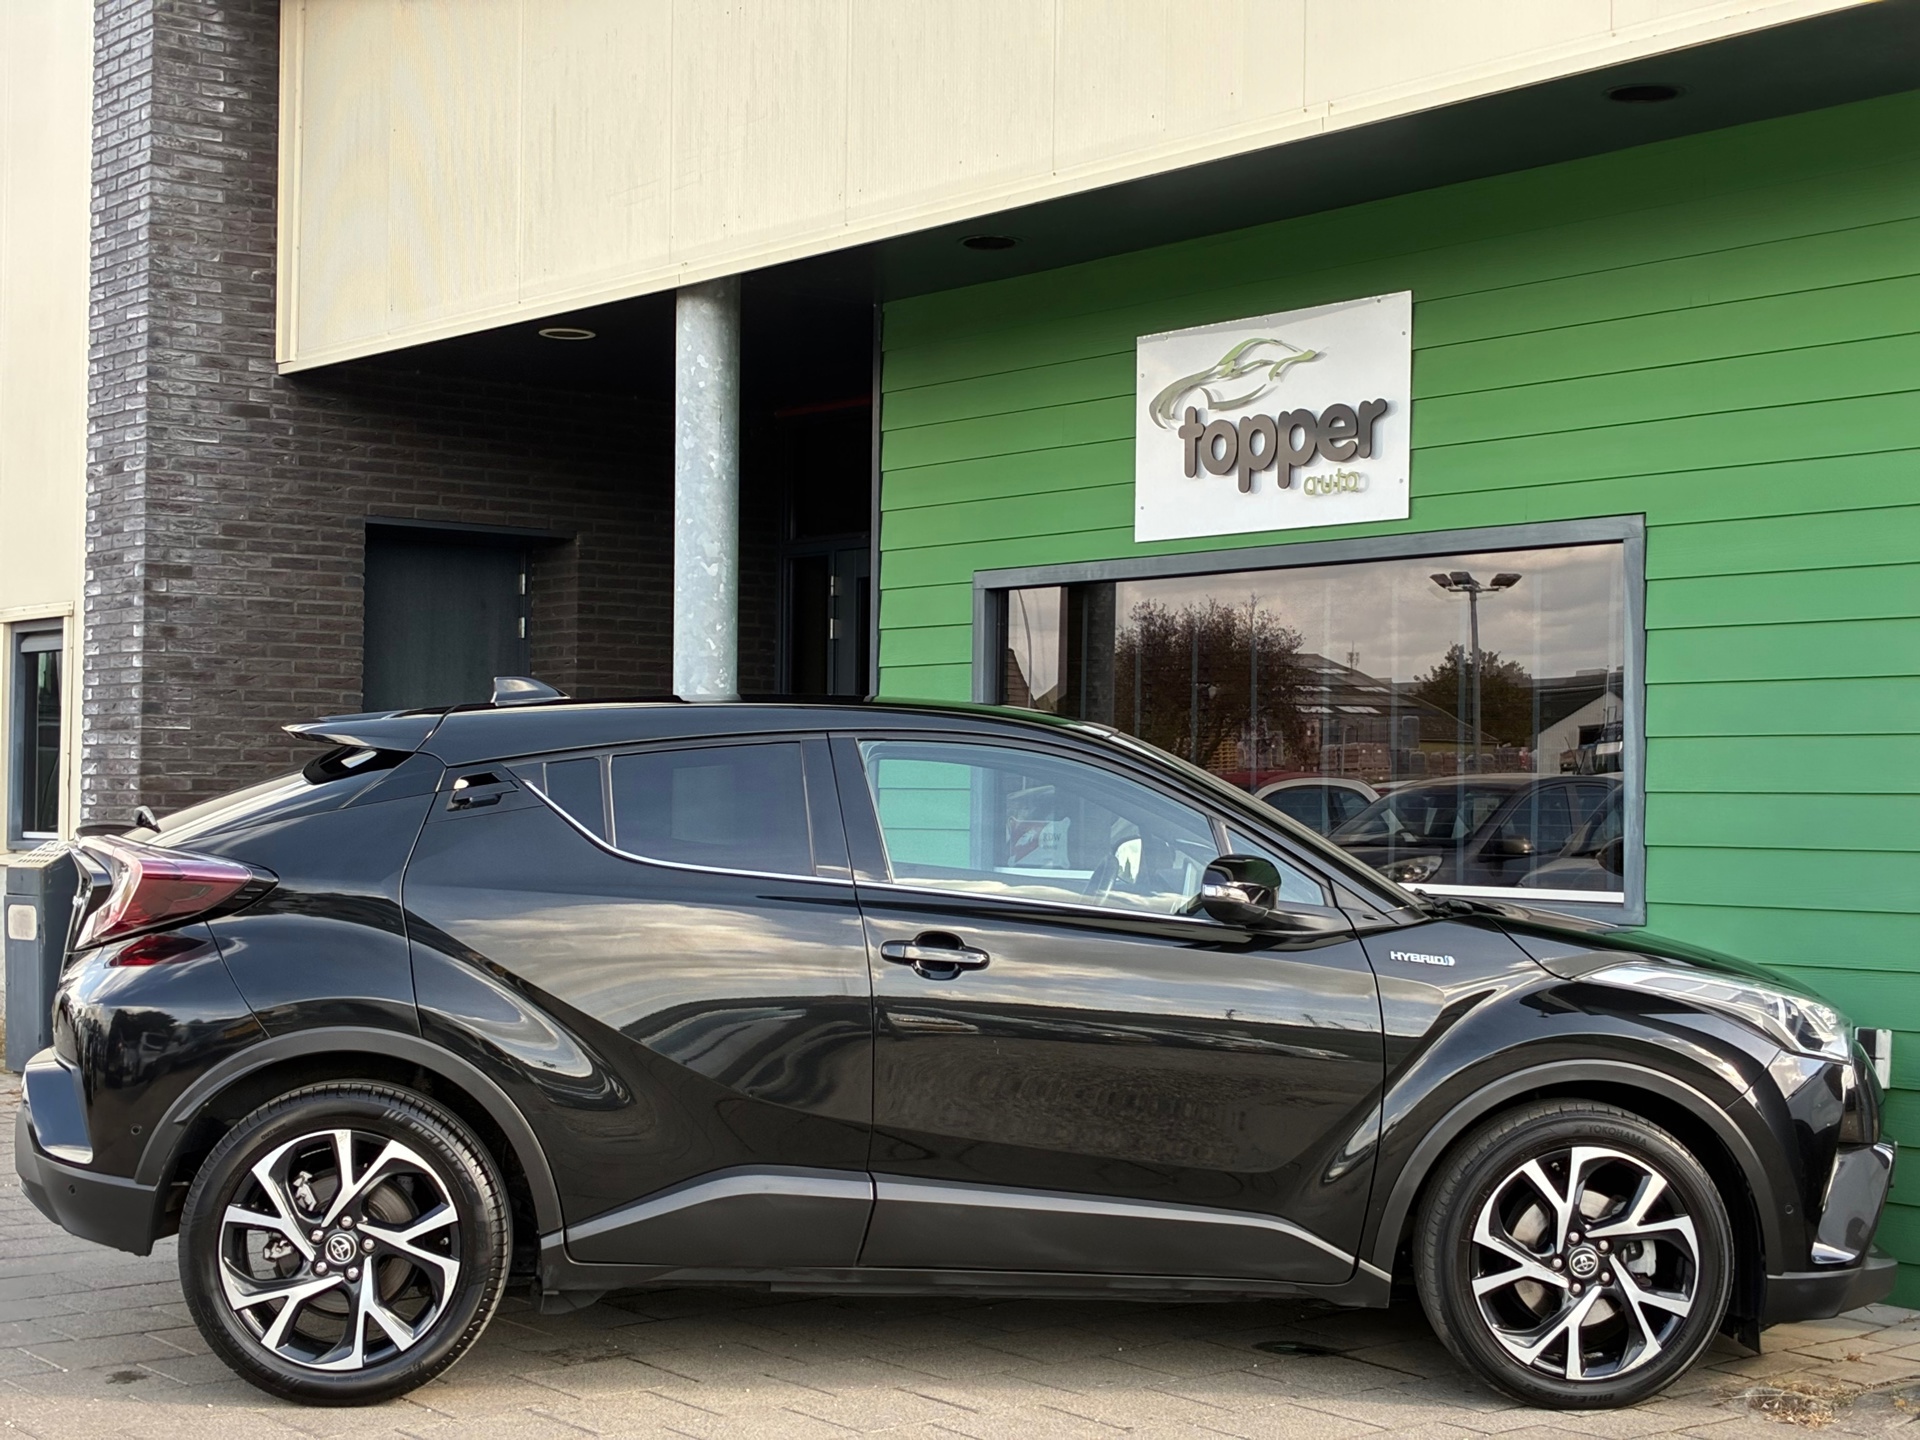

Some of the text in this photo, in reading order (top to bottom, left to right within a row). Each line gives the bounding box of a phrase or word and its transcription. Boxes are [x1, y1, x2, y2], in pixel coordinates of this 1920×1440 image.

[1178, 398, 1388, 493] topper
[1303, 468, 1360, 495] auto
[1390, 951, 1445, 965] HYBRID
[1588, 1124, 1647, 1147] YOKOHAMA
